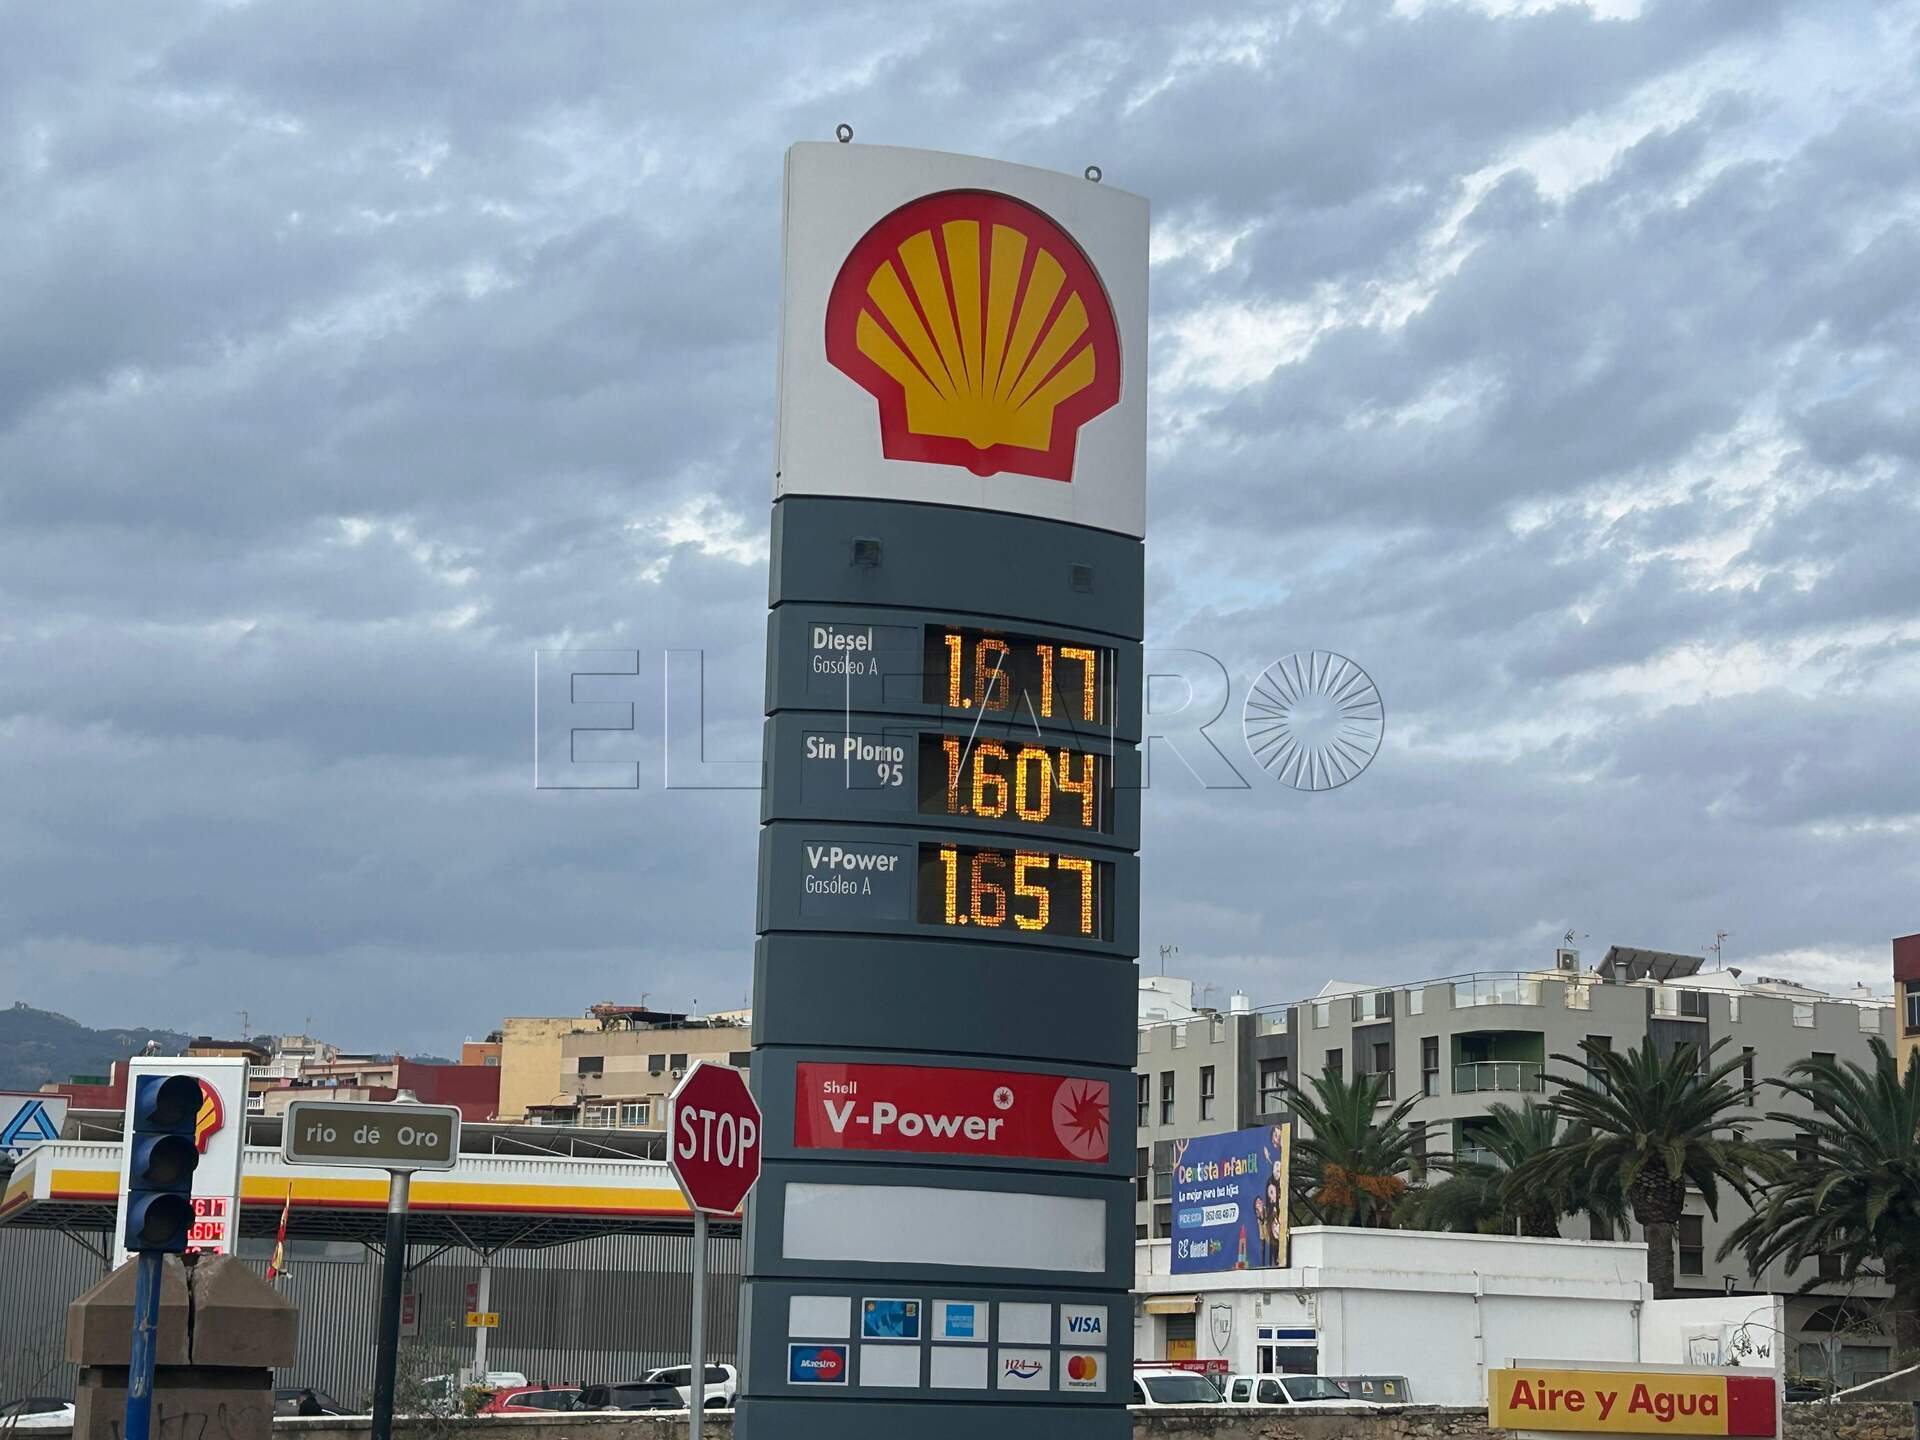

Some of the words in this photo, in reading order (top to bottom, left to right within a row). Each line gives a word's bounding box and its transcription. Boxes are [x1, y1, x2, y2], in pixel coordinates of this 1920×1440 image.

[814, 627, 873, 652] Diesel
[813, 654, 865, 675] Gasóleo
[868, 657, 878, 676] A
[945, 634, 1095, 722] 1.617
[806, 737, 836, 759] Sin
[844, 738, 904, 763] Plomo
[877, 764, 903, 787] 95
[943, 736, 1094, 827] 1.604
[806, 846, 899, 872] V-Power
[805, 875, 858, 896] Gasóleo
[862, 879, 872, 896] A
[940, 848, 1093, 934] 1.657
[823, 1081, 857, 1096] Shell
[823, 1099, 1003, 1142] V-Power
[306, 1123, 337, 1143] rio
[353, 1125, 381, 1145] de
[397, 1126, 438, 1147] Oro
[678, 1105, 757, 1168] STOP
[1178, 1161, 1219, 1184] Dentista
[1067, 1316, 1101, 1333] VISA
[801, 1359, 836, 1369] Maestro
[1508, 1379, 1585, 1412] Aire
[1594, 1391, 1618, 1420] y
[1628, 1383, 1719, 1422] Agua
